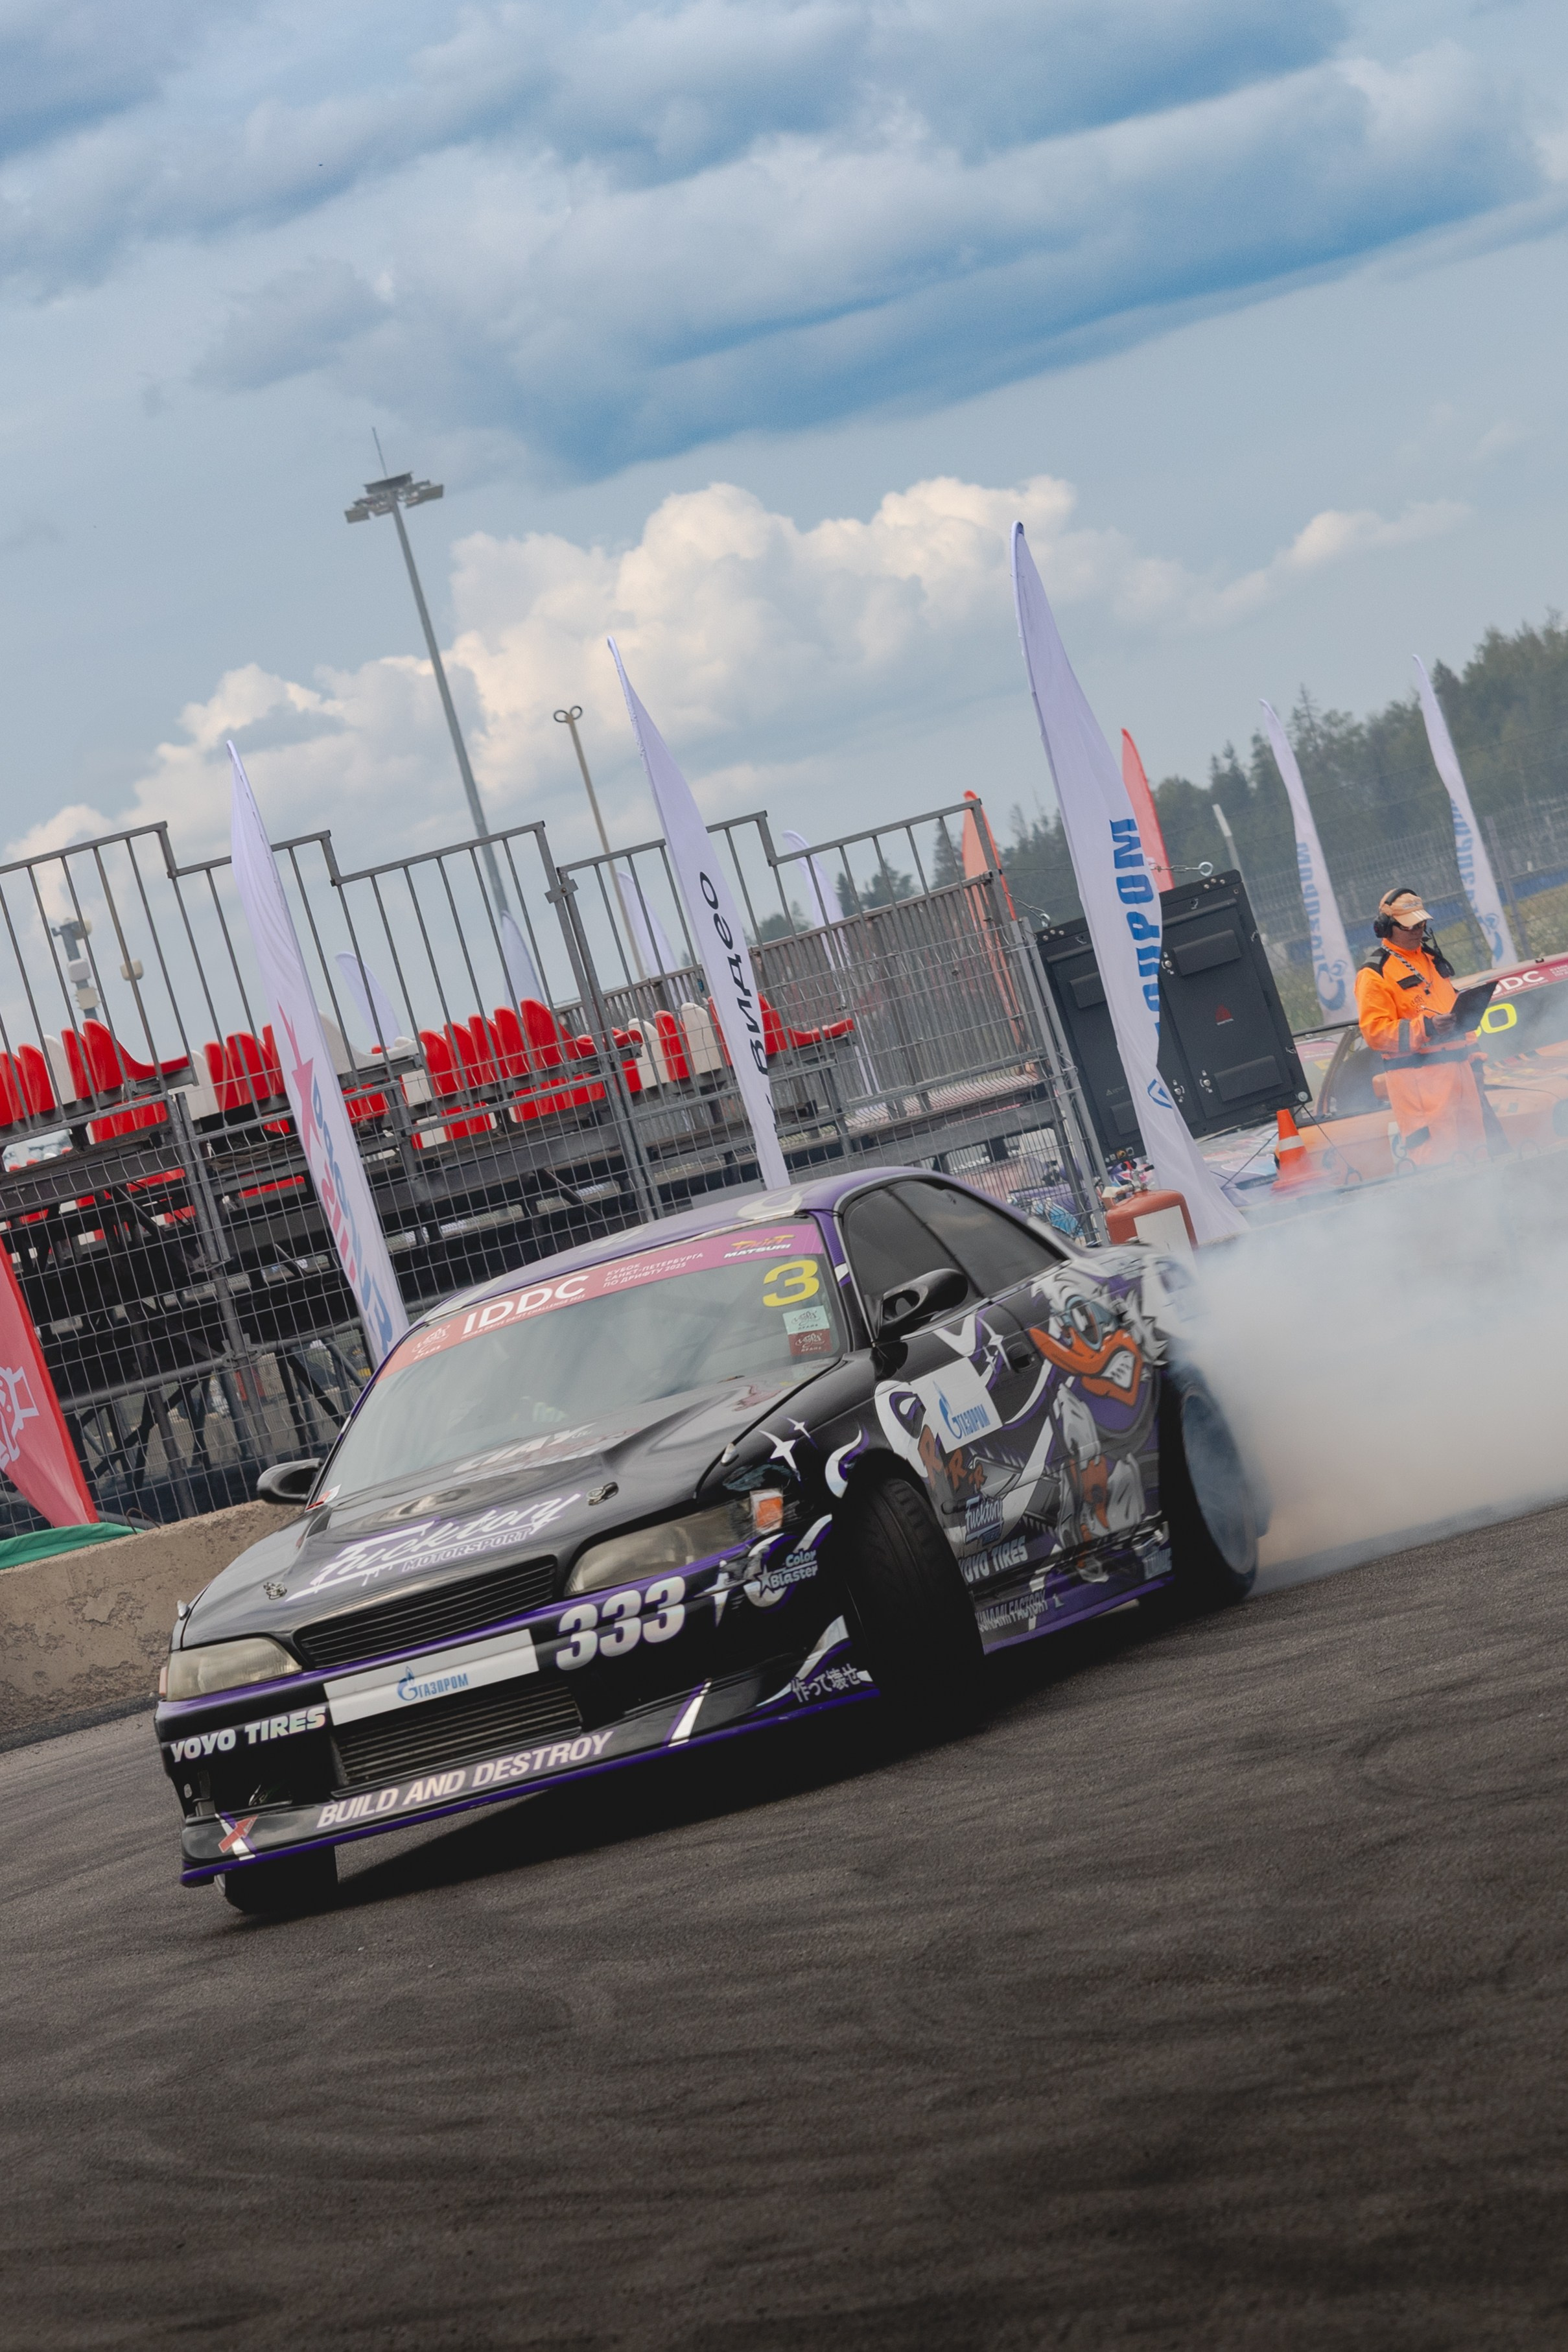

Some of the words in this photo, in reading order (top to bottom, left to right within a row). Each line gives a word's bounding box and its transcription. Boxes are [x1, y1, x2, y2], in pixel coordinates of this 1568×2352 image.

[604, 1252, 704, 1282] САНКТ-ПЕТЕРБУРГА
[723, 1243, 791, 1259] MATSURI
[602, 1278, 618, 1288] ПО
[618, 1267, 664, 1284] ДРИФТУ
[664, 1262, 688, 1272] 2025
[606, 1262, 641, 1276] КУБОК
[762, 1260, 820, 1307] 3
[462, 1275, 589, 1335] IDDC
[401, 1527, 533, 1572] MOTORSPORT
[786, 1550, 816, 1568] Color
[991, 1535, 1028, 1571] TIRES
[770, 1564, 818, 1588] Blaster
[1006, 1588, 1049, 1622] FACTORY
[556, 1576, 686, 1671] 333
[418, 1673, 469, 1699] ГАЗПРОМ
[791, 1664, 861, 1702] 作って壊せ
[170, 1729, 237, 1763] YOYO
[244, 1706, 325, 1744] TIRES
[316, 1787, 399, 1828] BUILD
[402, 1770, 467, 1806] AND
[471, 1732, 613, 1787] DESTROY
